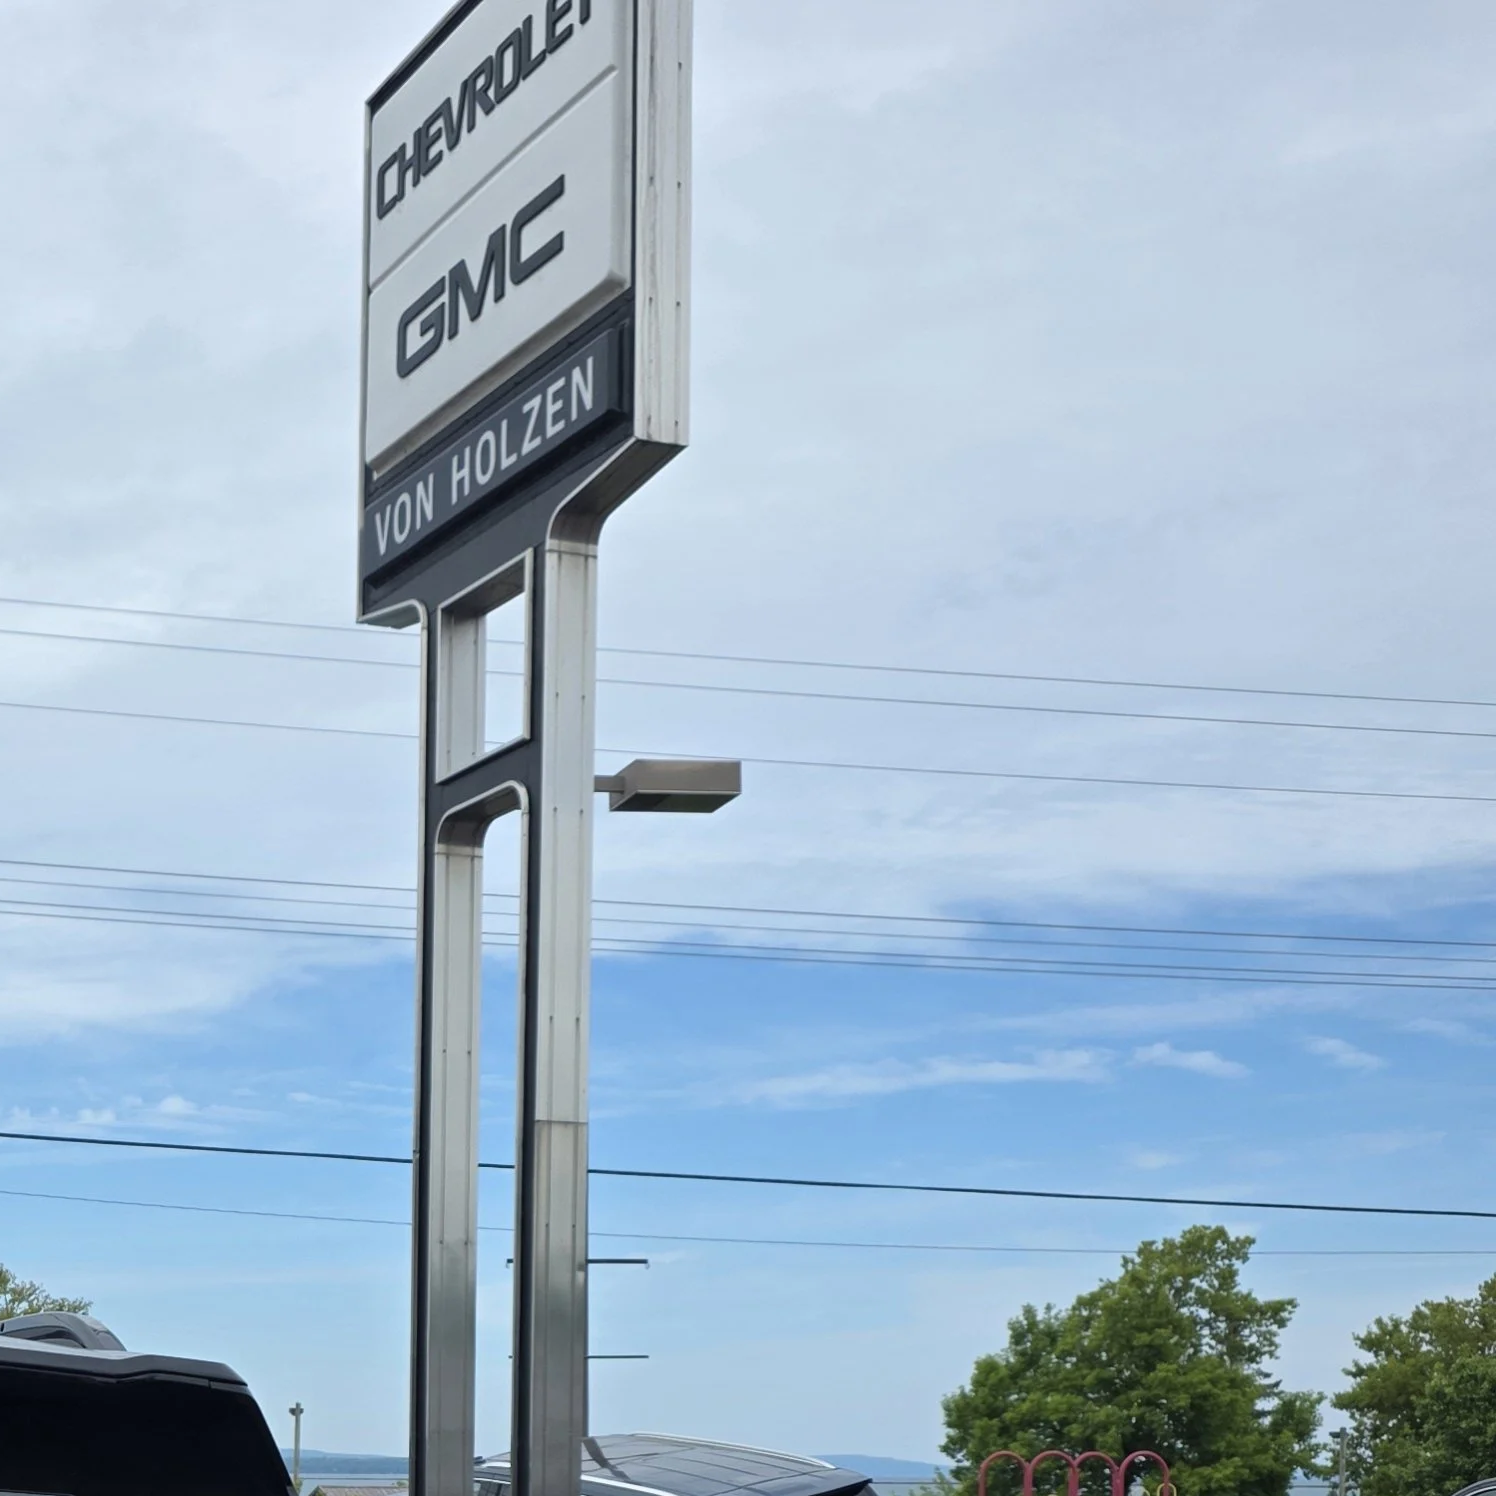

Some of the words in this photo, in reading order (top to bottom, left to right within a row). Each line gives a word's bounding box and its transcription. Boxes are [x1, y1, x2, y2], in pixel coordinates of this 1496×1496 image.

[396, 173, 565, 378] GMC
[375, 473, 435, 556] VON
[451, 356, 594, 506] HOLZEN
